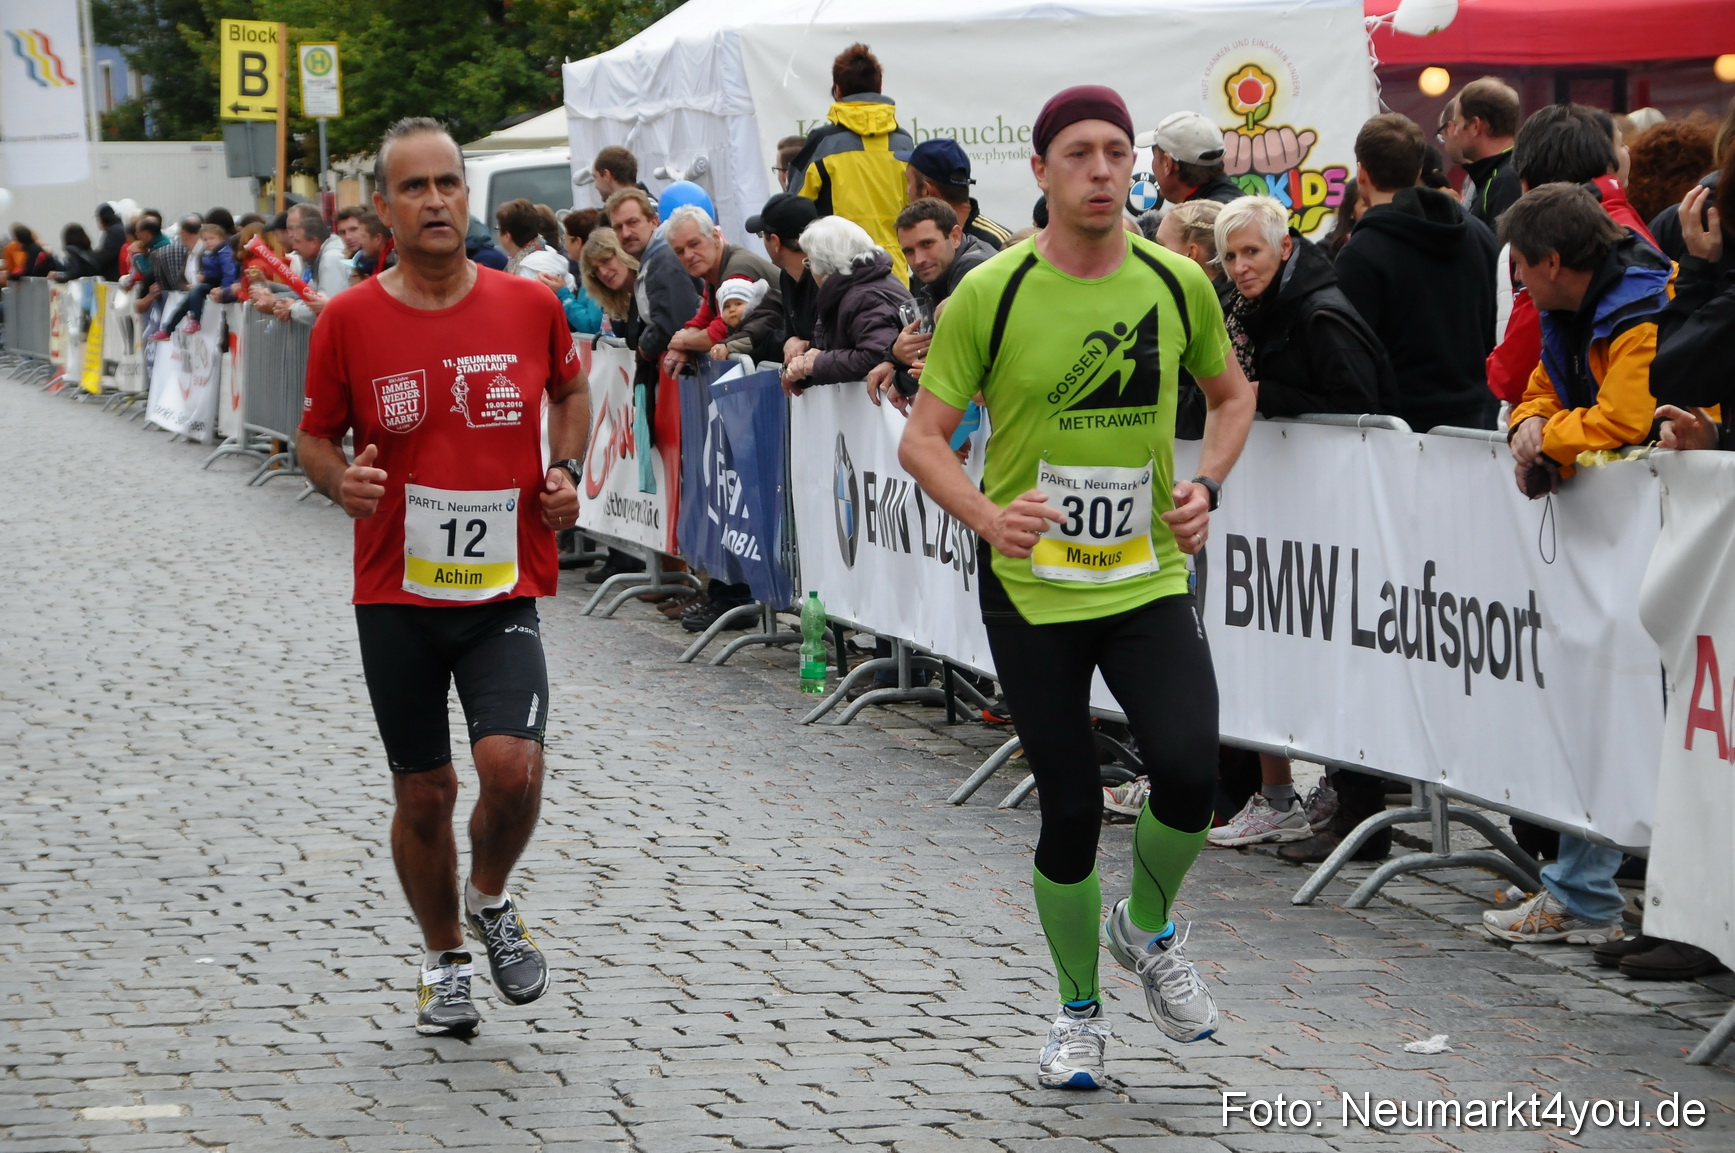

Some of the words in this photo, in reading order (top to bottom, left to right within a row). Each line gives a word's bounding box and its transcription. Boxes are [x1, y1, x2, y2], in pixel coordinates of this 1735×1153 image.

[229, 24, 278, 43] Block
[238, 50, 268, 97] B
[1204, 45, 1231, 77] KRANKEN
[1232, 38, 1250, 49] UND
[1251, 37, 1290, 62] EINSAMEN
[1286, 61, 1301, 97] KINDERN
[911, 114, 1033, 146] brauche
[443, 358, 456, 368] 11.
[456, 354, 518, 366] NEUMARKTER
[456, 363, 508, 374] STADTLAUF
[1047, 345, 1102, 404] GOSSEN
[381, 380, 418, 395] IMMER
[381, 389, 421, 404] WIEDER
[384, 399, 418, 417] NEU
[485, 401, 523, 409] 19.09.2010
[385, 412, 420, 427] MARKT
[1059, 411, 1157, 430] METRAWATT
[1041, 472, 1081, 490] PARTL
[408, 495, 444, 511] PARTL
[448, 502, 502, 512] Neumarkt
[1060, 495, 1134, 539] 302
[440, 518, 487, 558] 12
[1066, 547, 1122, 567] Markus
[434, 567, 482, 585] Achim
[1225, 533, 1339, 641] BMW
[1351, 548, 1545, 696] Laufsport
[1684, 635, 1735, 766] A
